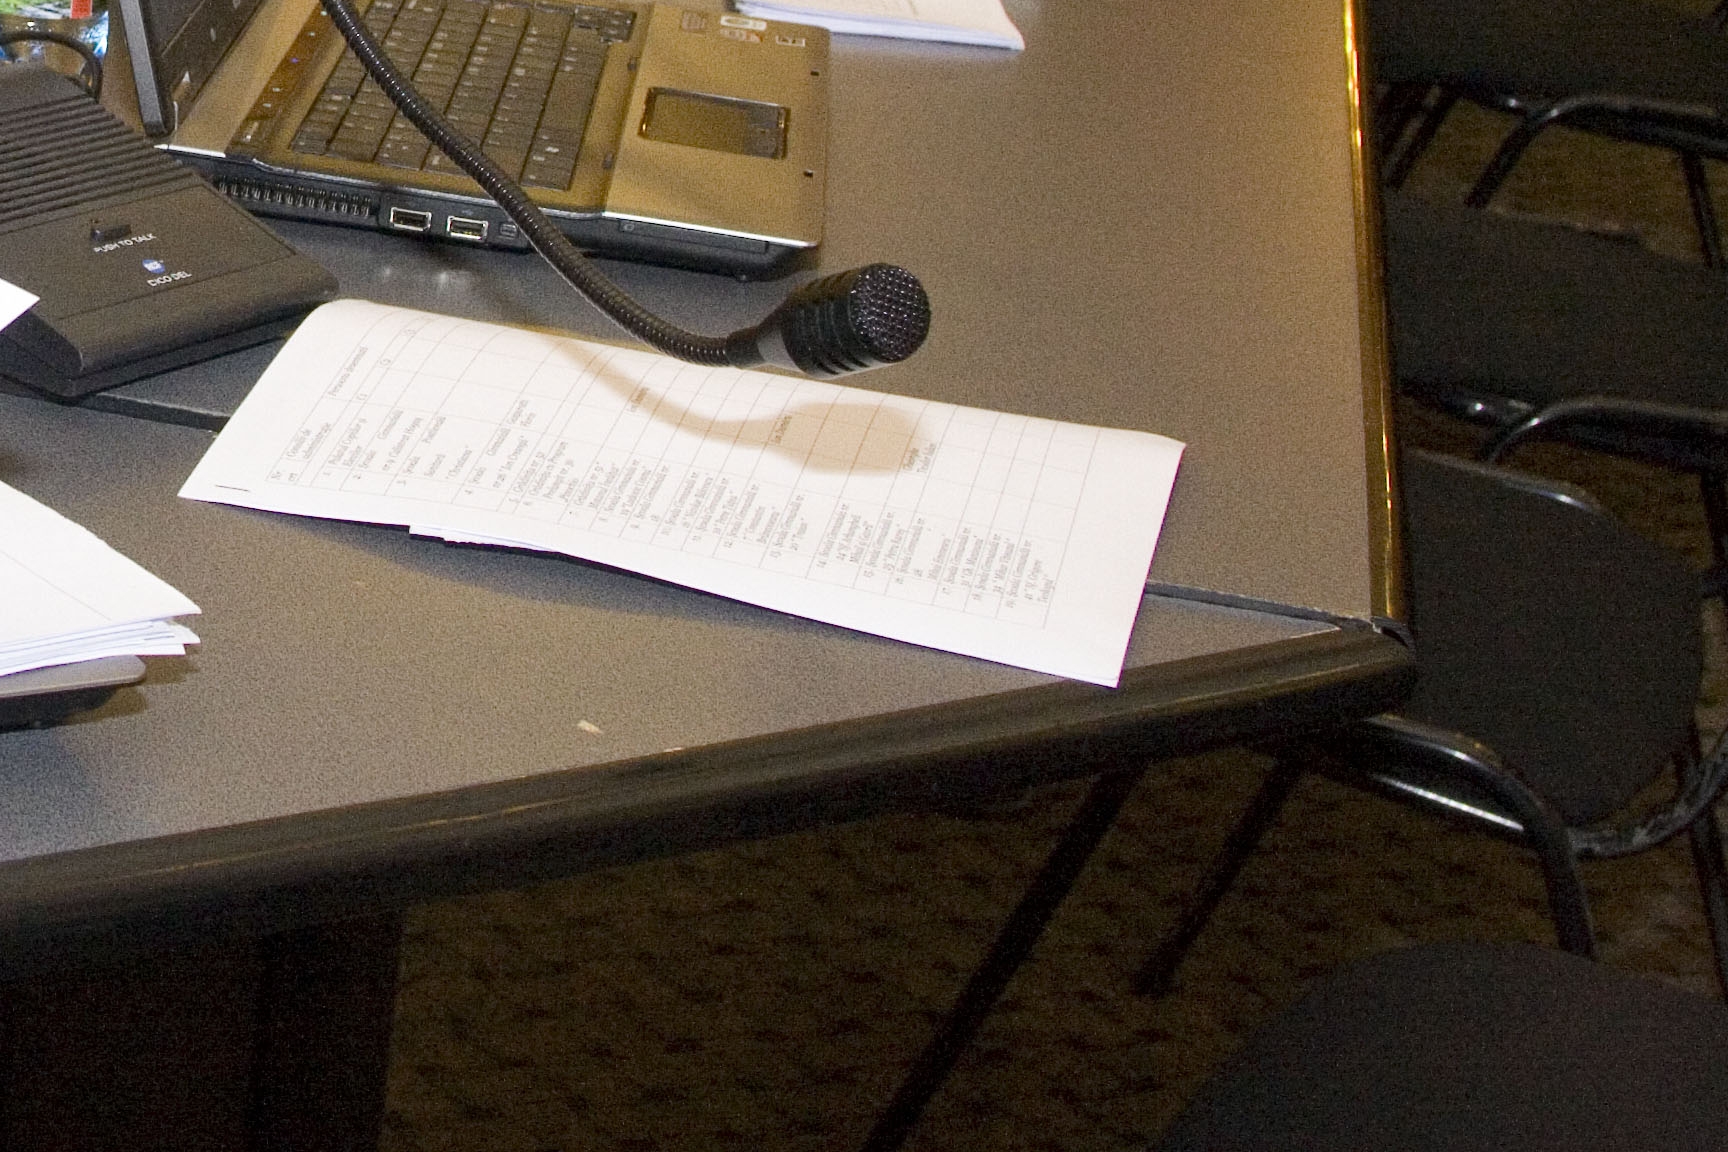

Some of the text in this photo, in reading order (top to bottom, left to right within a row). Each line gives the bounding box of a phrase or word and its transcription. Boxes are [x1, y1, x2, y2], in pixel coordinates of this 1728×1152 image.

[93, 233, 157, 253] PUSH TO TALK
